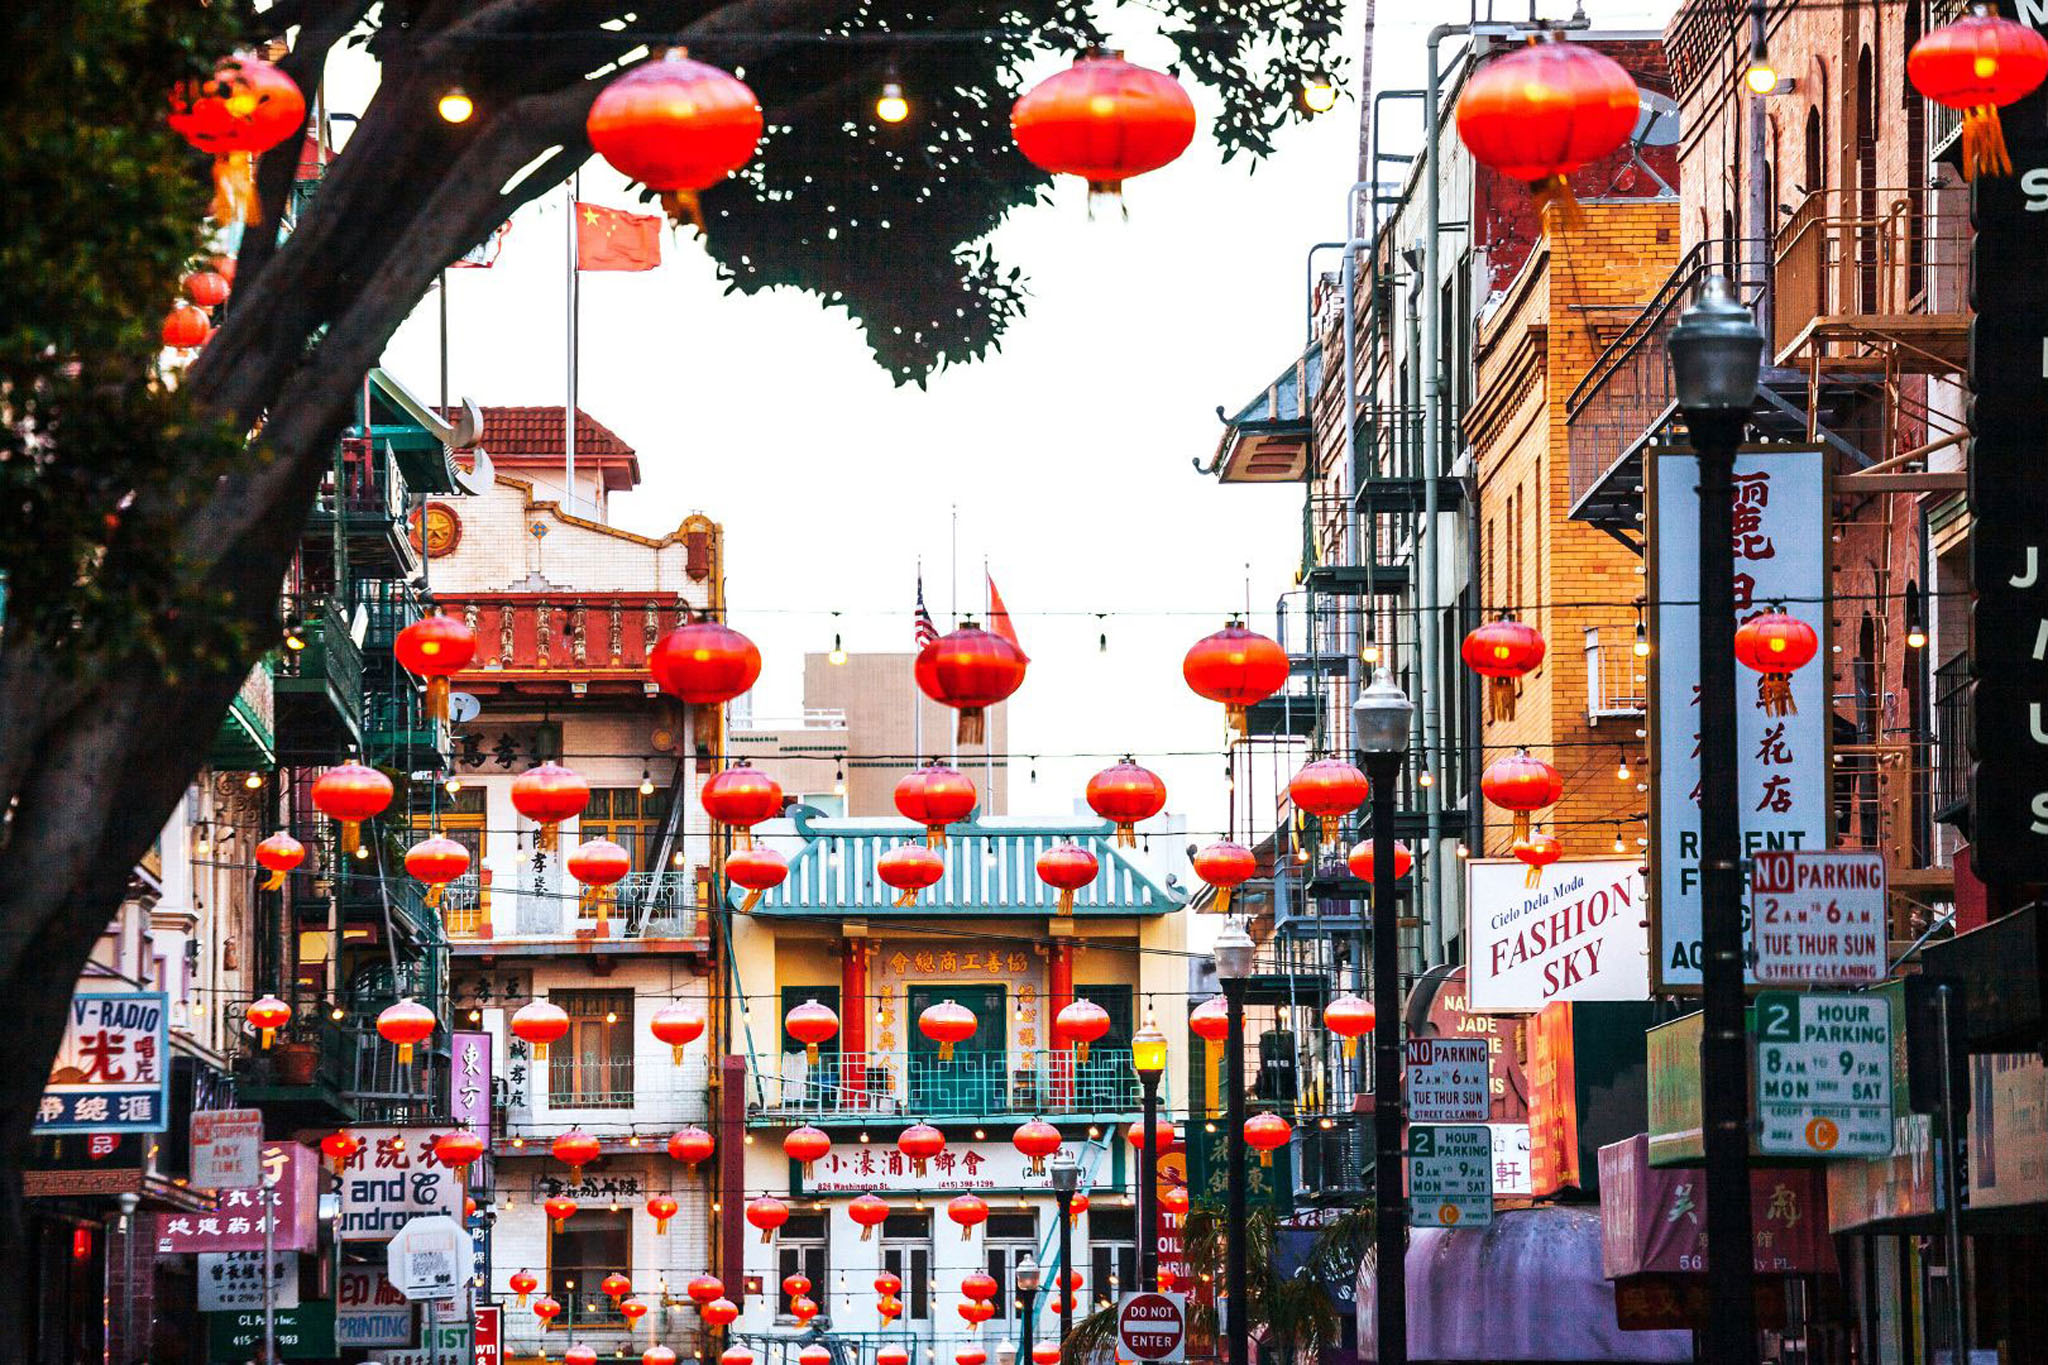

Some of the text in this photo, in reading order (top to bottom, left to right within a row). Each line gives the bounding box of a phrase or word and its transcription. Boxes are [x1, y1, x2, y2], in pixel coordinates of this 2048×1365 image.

[1756, 858, 1789, 888] NO
[1798, 864, 1880, 889] PARKING
[1491, 875, 1584, 930] Cielo Dela Moda
[1765, 898, 1779, 924] 2
[1827, 898, 1841, 924] 6
[1490, 875, 1633, 978] FASHION
[1765, 934, 1876, 956] TUE THUR SUN
[1543, 938, 1604, 999] SKY
[1766, 963, 1877, 978] STREET CLEANING
[1456, 1016, 1498, 1033] JADE
[1766, 1004, 1870, 1036] 2 HOUR
[1804, 1025, 1886, 1043] PARKING
[1408, 1042, 1430, 1063] NO
[1435, 1047, 1486, 1062] PARKING
[1767, 1049, 1781, 1073] 8
[1839, 1051, 1854, 1075] 9
[1414, 1069, 1424, 1084] 2
[1452, 1069, 1461, 1084] 6
[1414, 1091, 1483, 1105] TUE THUR SUN
[1765, 1080, 1809, 1098] MON
[1852, 1082, 1881, 1100] SAT
[1414, 1110, 1483, 1119] STREET CLEANING
[1415, 1133, 1430, 1153] 2
[1446, 1133, 1478, 1144] HOUR
[1437, 1145, 1489, 1157] PARKING
[1415, 1161, 1424, 1178] 8
[1459, 1162, 1468, 1177] 9
[351, 1171, 406, 1203] and
[834, 1182, 878, 1191] Washington
[1414, 1181, 1441, 1192] MON
[1467, 1181, 1486, 1192] SAT
[435, 1302, 456, 1311] TIME
[1131, 1306, 1173, 1317] DO NOT
[339, 1315, 408, 1339] PRINTING
[1131, 1335, 1172, 1348] ENTER
